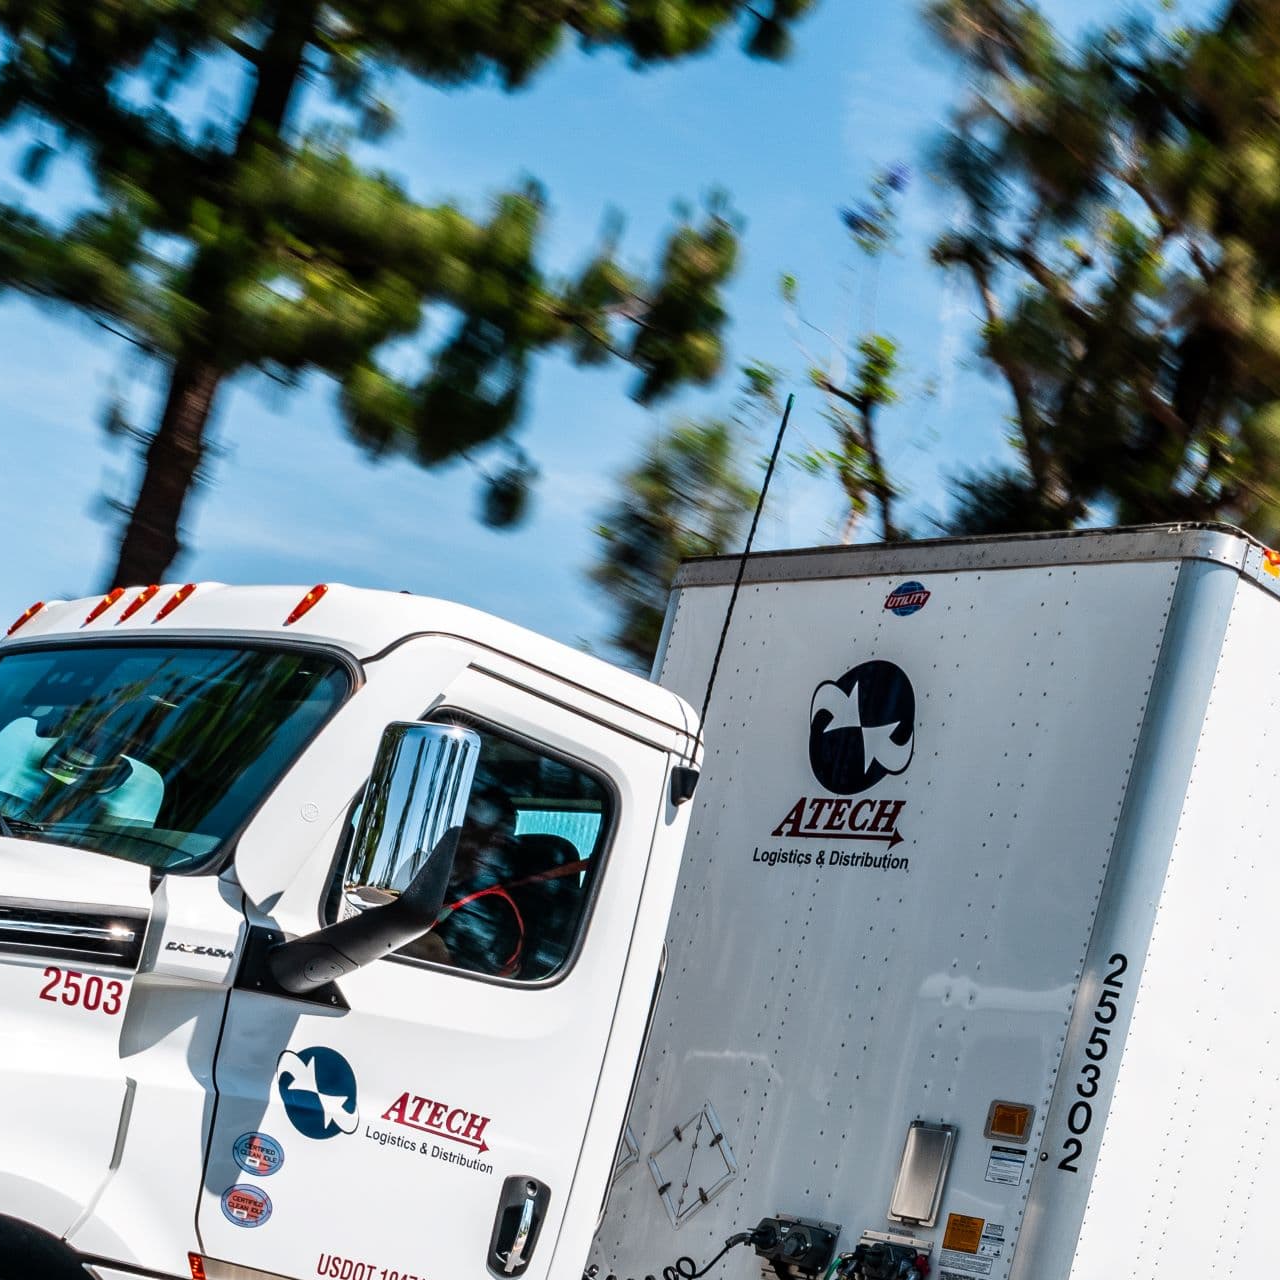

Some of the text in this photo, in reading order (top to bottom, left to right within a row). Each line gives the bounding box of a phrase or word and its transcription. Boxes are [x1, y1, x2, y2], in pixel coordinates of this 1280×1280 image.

[887, 592, 929, 607] UTILITY
[771, 797, 906, 837] ATECH
[753, 847, 909, 870] Logistics & Distribution
[39, 966, 124, 1015] 2503
[1057, 953, 1128, 1173] 255302
[381, 1092, 490, 1141] ATECH
[365, 1125, 493, 1175] Logistics & Distribution
